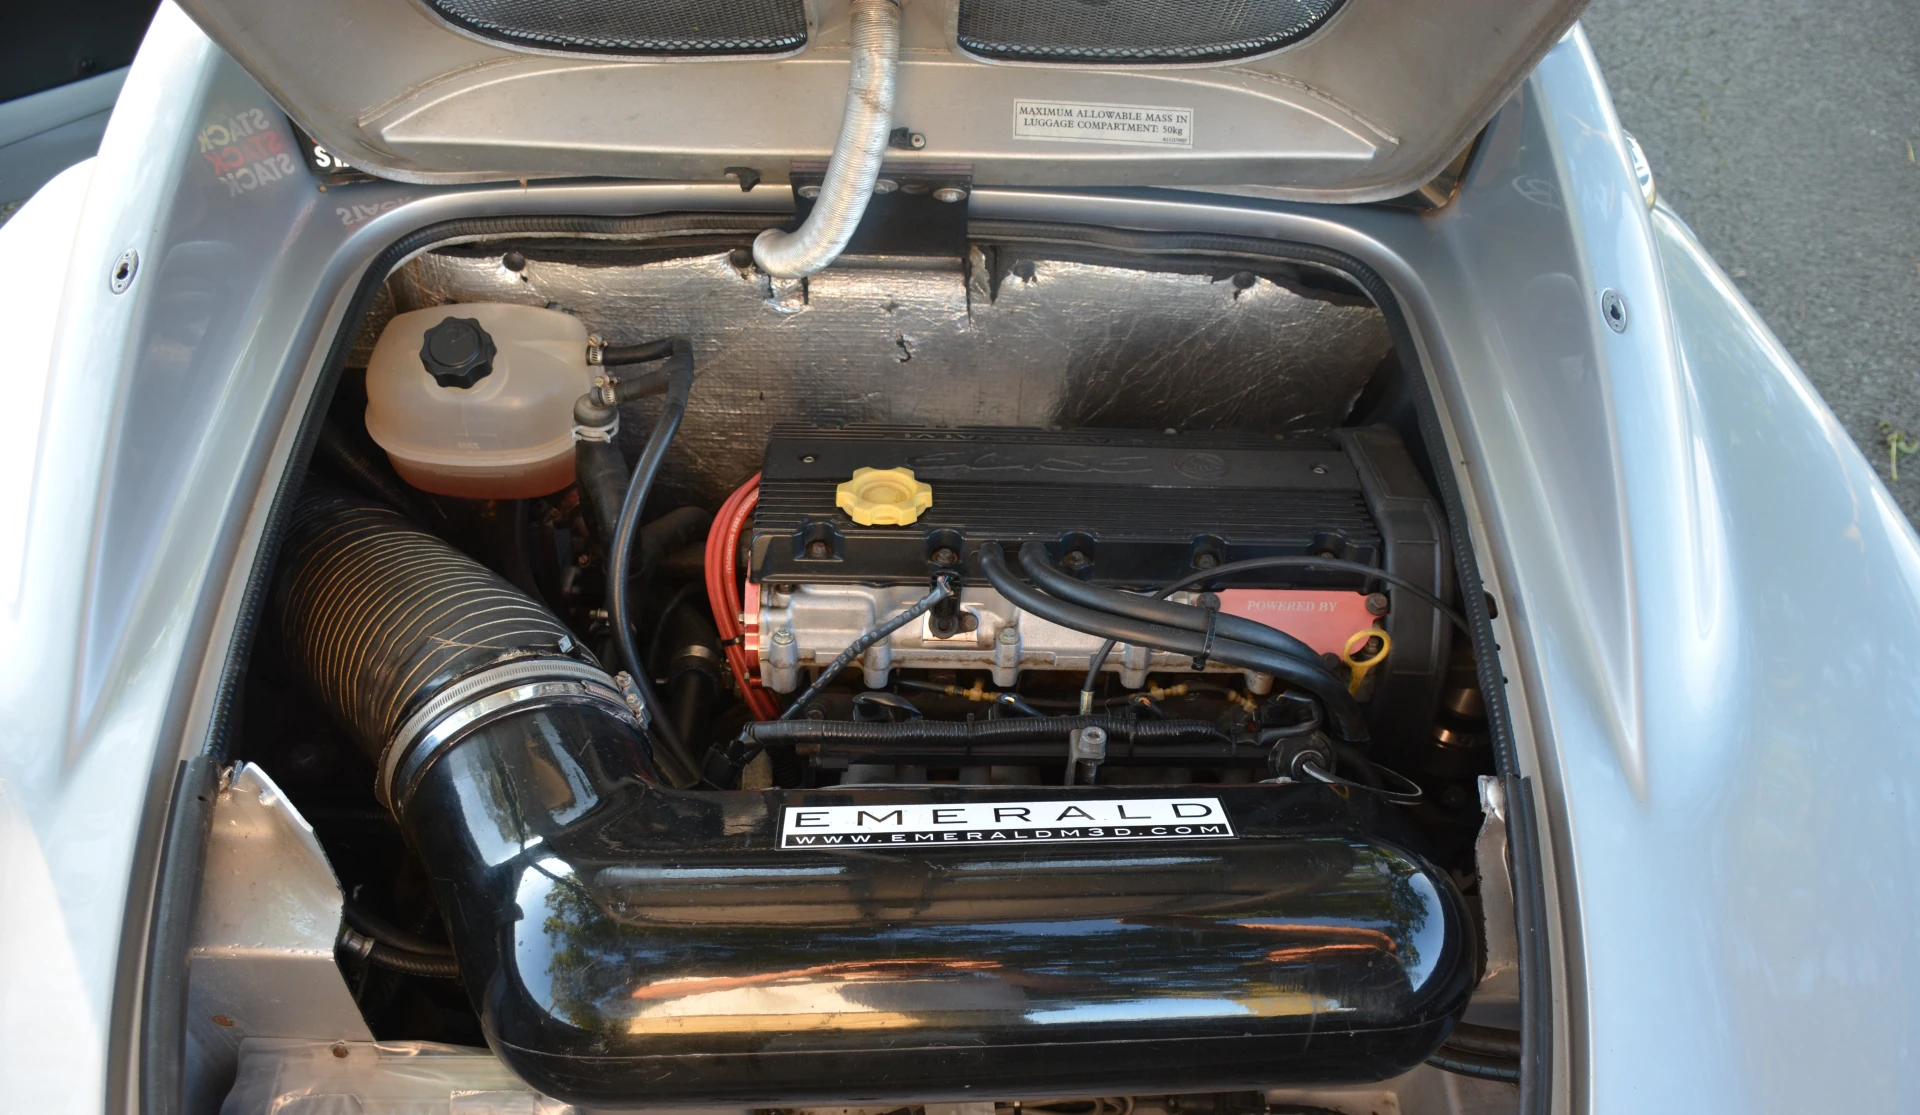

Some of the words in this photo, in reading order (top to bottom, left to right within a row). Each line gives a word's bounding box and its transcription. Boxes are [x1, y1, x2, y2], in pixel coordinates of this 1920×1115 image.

[1019, 106, 1073, 117] MAXIMUM
[1077, 109, 1142, 121] ALLOWABLE
[1145, 114, 1173, 123] MASS
[1176, 115, 1188, 123] IN
[1024, 118, 1074, 129] LUGGAGE
[1077, 121, 1159, 133] COMPARTMENT:
[1162, 125, 1183, 136] 50kg
[1246, 600, 1315, 612] POWERED
[1319, 601, 1338, 612] BY
[794, 803, 1213, 827] EMERALD
[795, 825, 1220, 845] WWW.EMERALDM3D.COM
